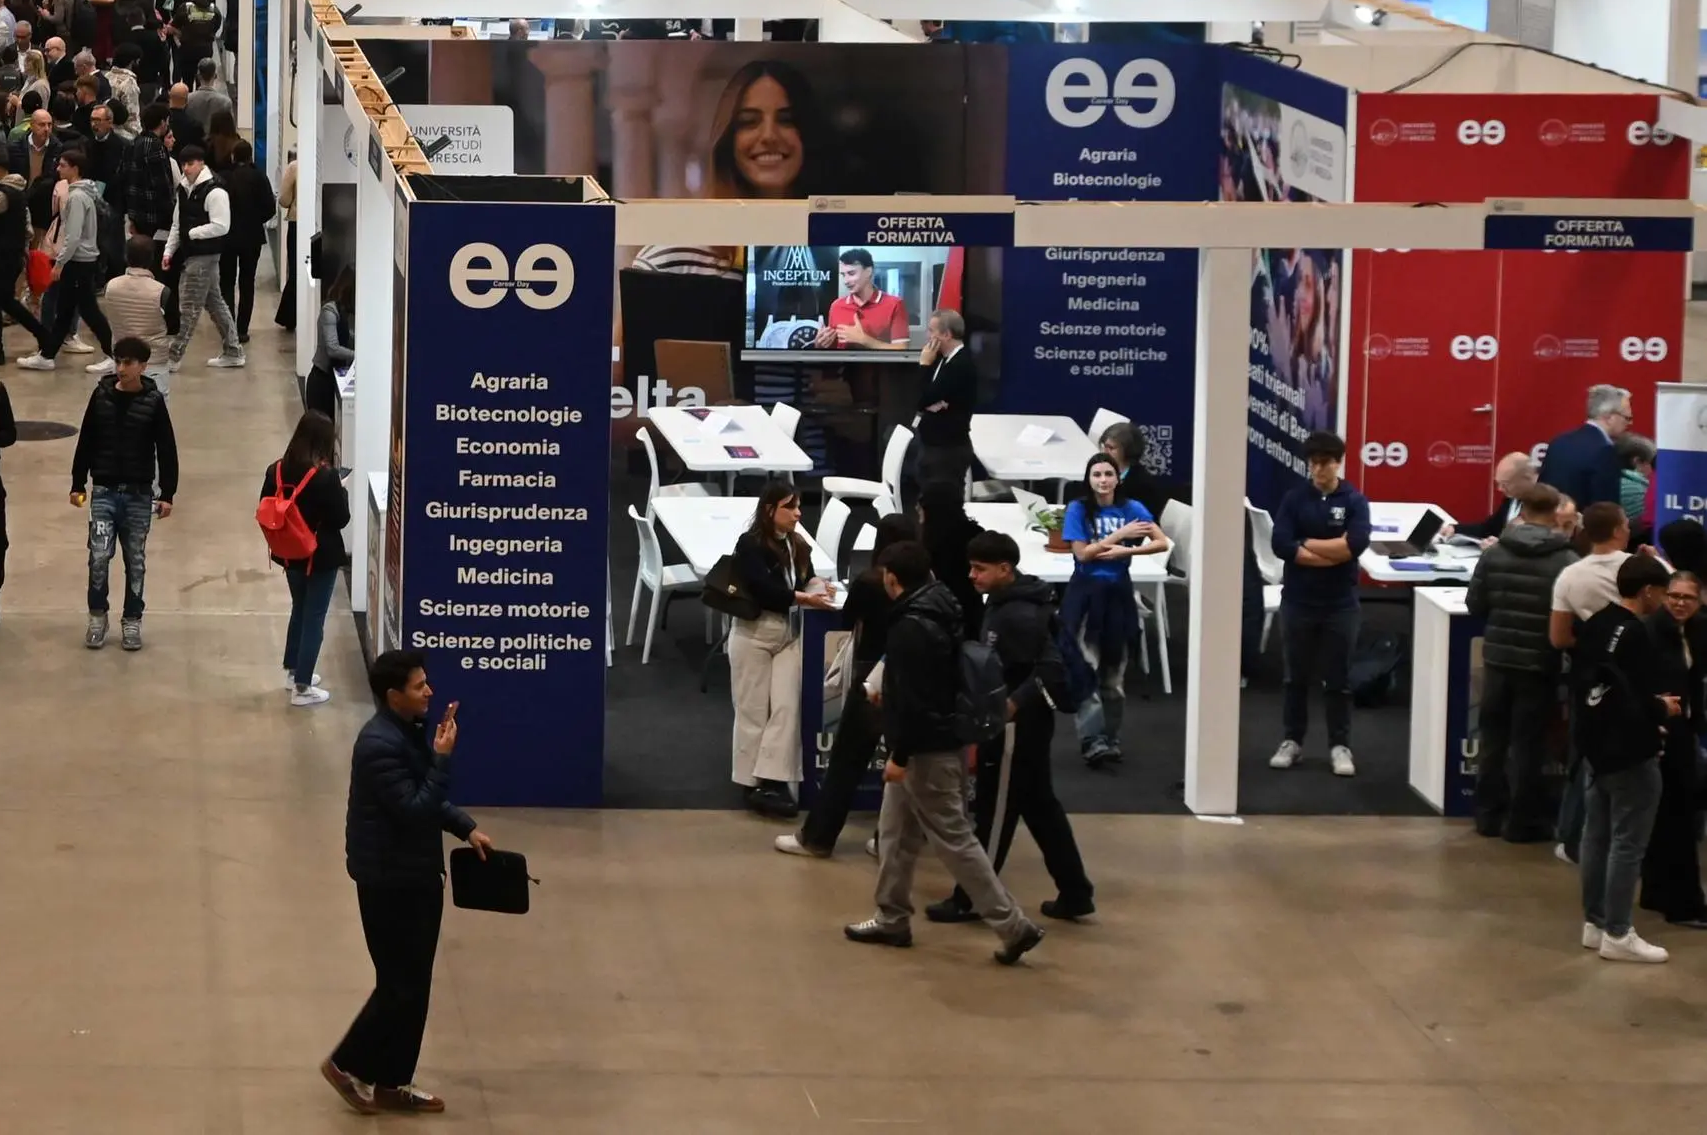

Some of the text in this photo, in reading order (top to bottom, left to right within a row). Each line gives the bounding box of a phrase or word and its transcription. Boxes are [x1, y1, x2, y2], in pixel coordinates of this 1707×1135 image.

[410, 125, 481, 137] UNIVERSITÀ
[1079, 147, 1137, 164] Agraria
[1053, 172, 1162, 190] Biotecnologie
[877, 216, 945, 230] OFFERTA
[1555, 219, 1624, 233] OFFERTA
[867, 230, 955, 244] FORMATIVA
[1544, 233, 1634, 248] FORMATIVA
[1045, 246, 1165, 264] Giurisprudenza
[763, 269, 831, 281] INCEPTUM
[1062, 272, 1146, 289] Ingegneria
[493, 280, 530, 289] Career Day
[1068, 296, 1140, 311] Medicina
[1039, 321, 1167, 336] Scienze motorie
[1034, 346, 1167, 363] Scienze politiche
[1070, 363, 1134, 376] e sociali
[471, 372, 548, 392] Agraria
[1265, 367, 1306, 411] triennali
[436, 404, 582, 427] Biotecnologie
[1279, 408, 1289, 434] di
[456, 437, 560, 456] Economia
[1266, 440, 1292, 468] entro
[459, 469, 556, 488] Farmacia
[1664, 494, 1707, 511] IL D
[425, 501, 588, 523] Giurisprudenza
[449, 534, 563, 556] Ingegneria
[457, 567, 554, 585] Medicina
[419, 598, 590, 618] Scienze motorie
[412, 631, 592, 653] Scienze politiche
[461, 654, 546, 670] e sociali
